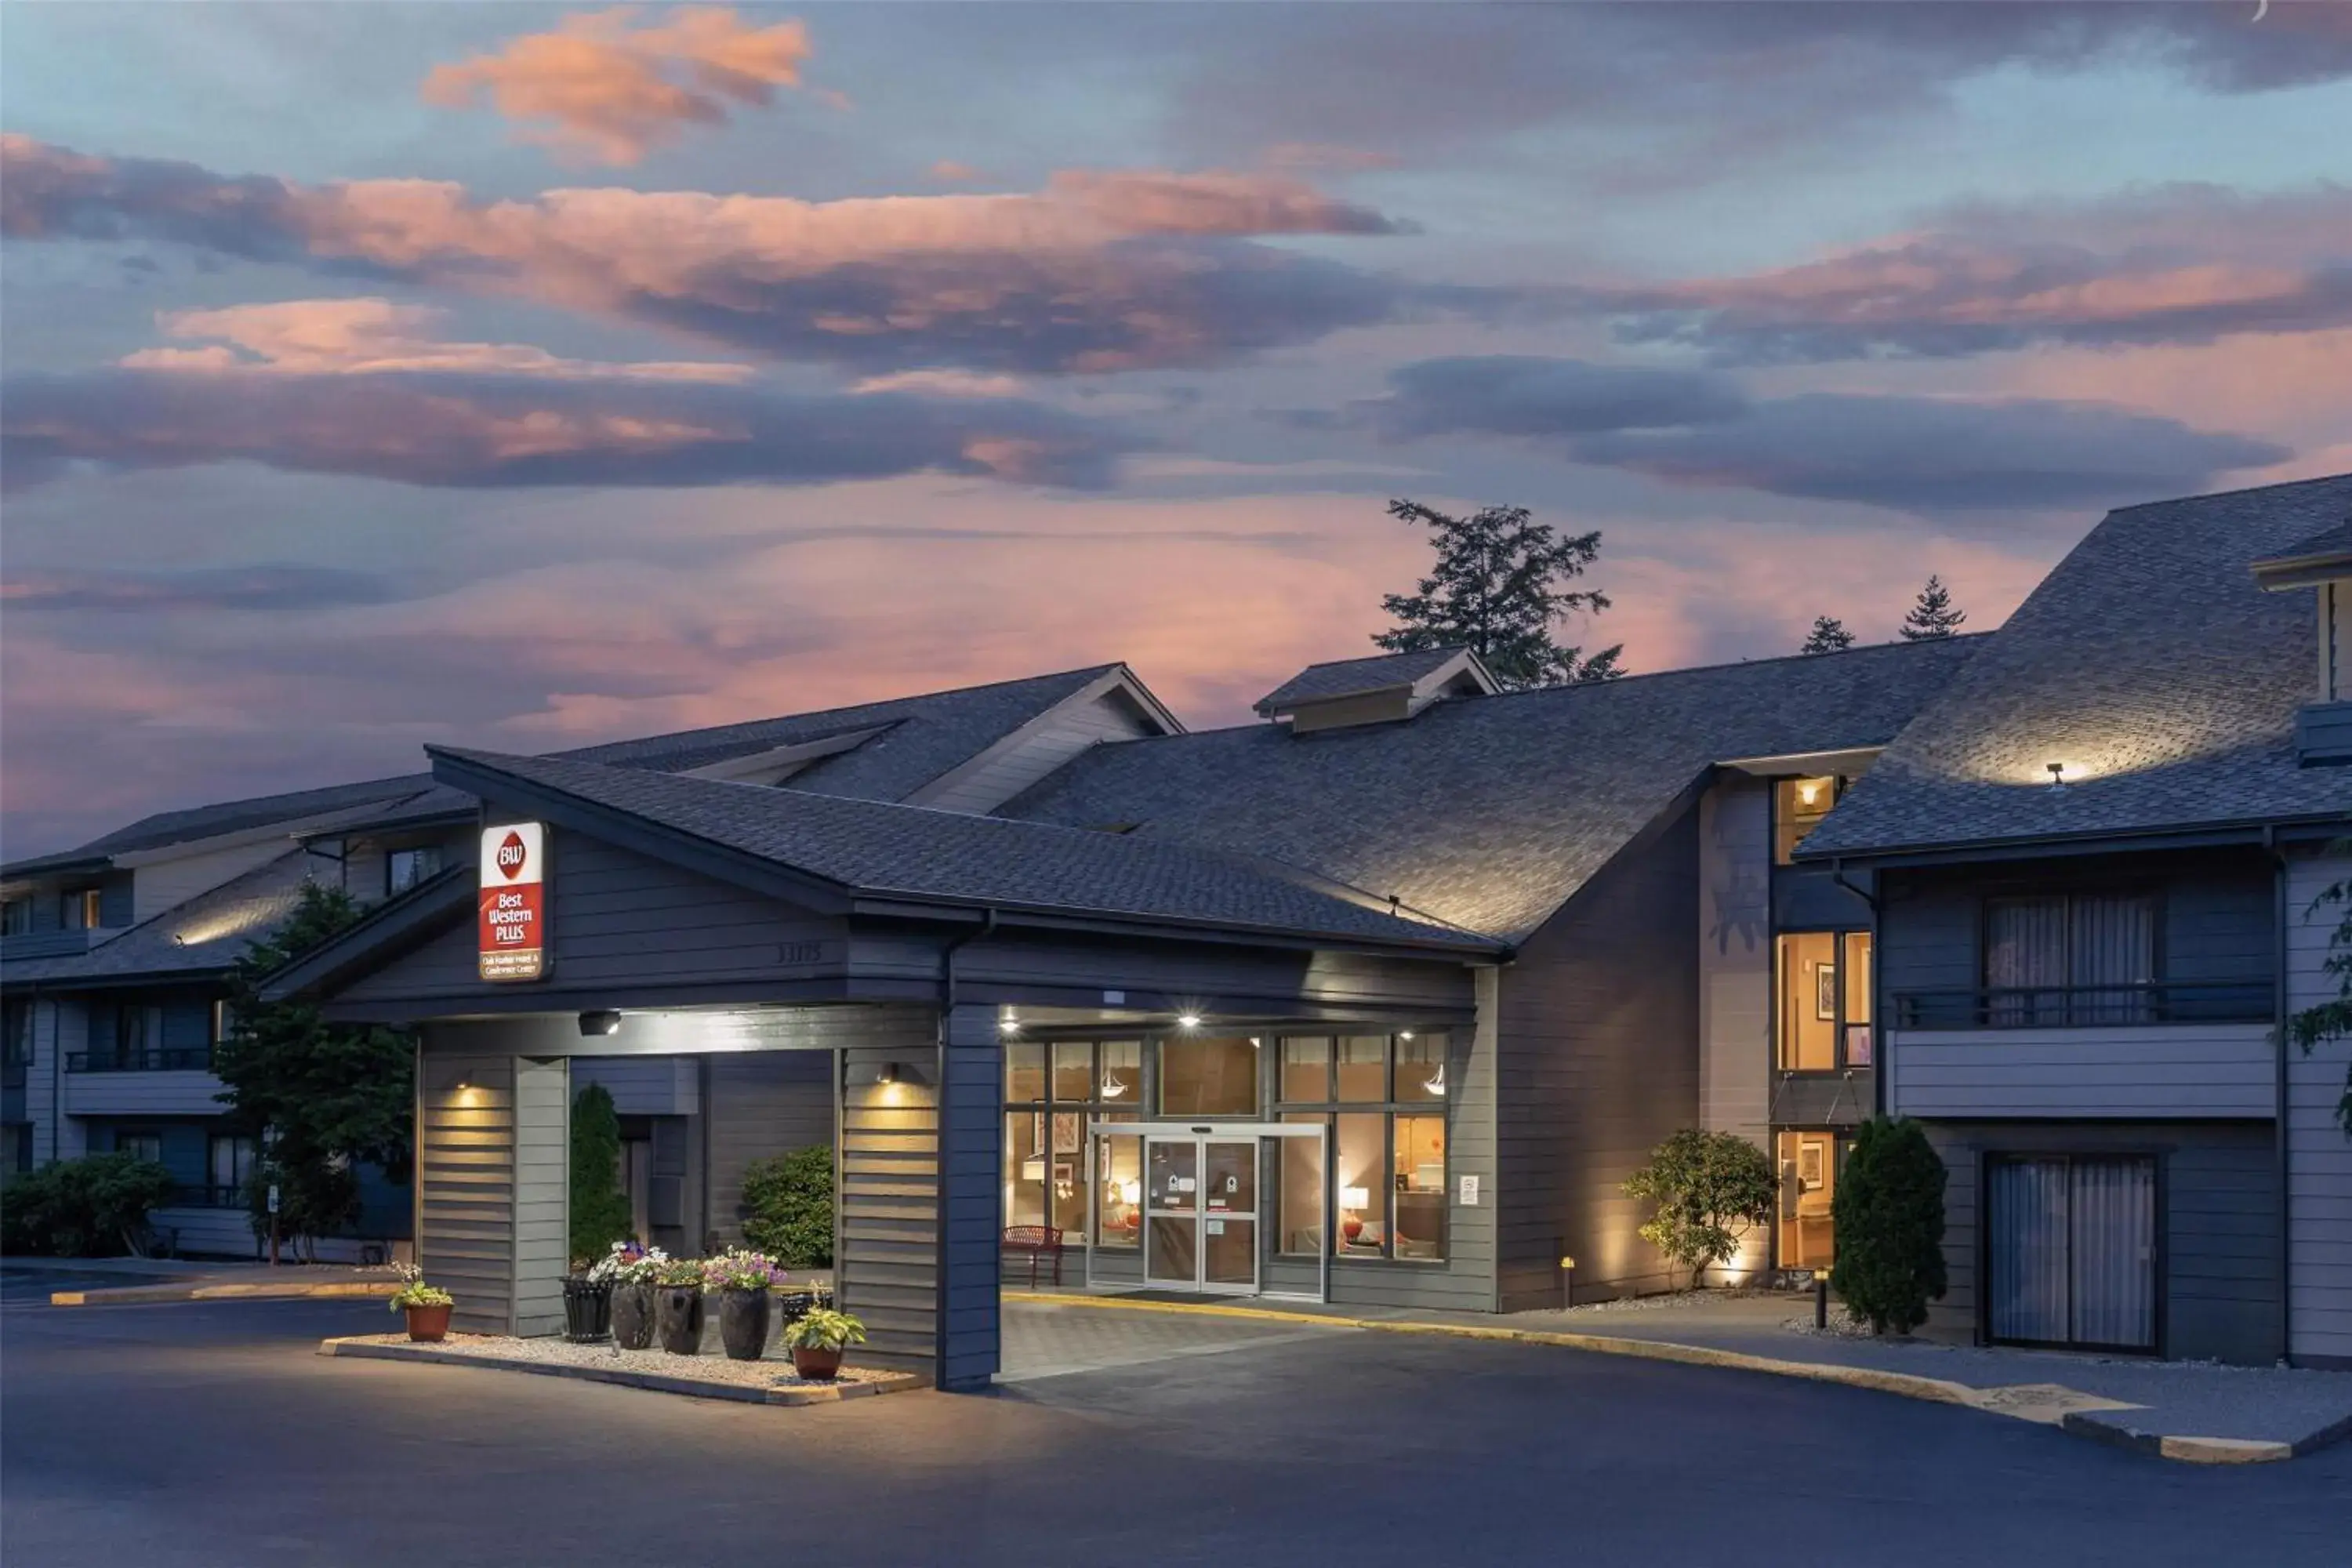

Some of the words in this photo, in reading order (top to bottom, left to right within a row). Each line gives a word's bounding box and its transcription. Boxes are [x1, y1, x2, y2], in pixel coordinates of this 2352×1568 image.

[500, 846, 522, 865] BW
[499, 894, 522, 908] Best
[489, 909, 532, 924] Western
